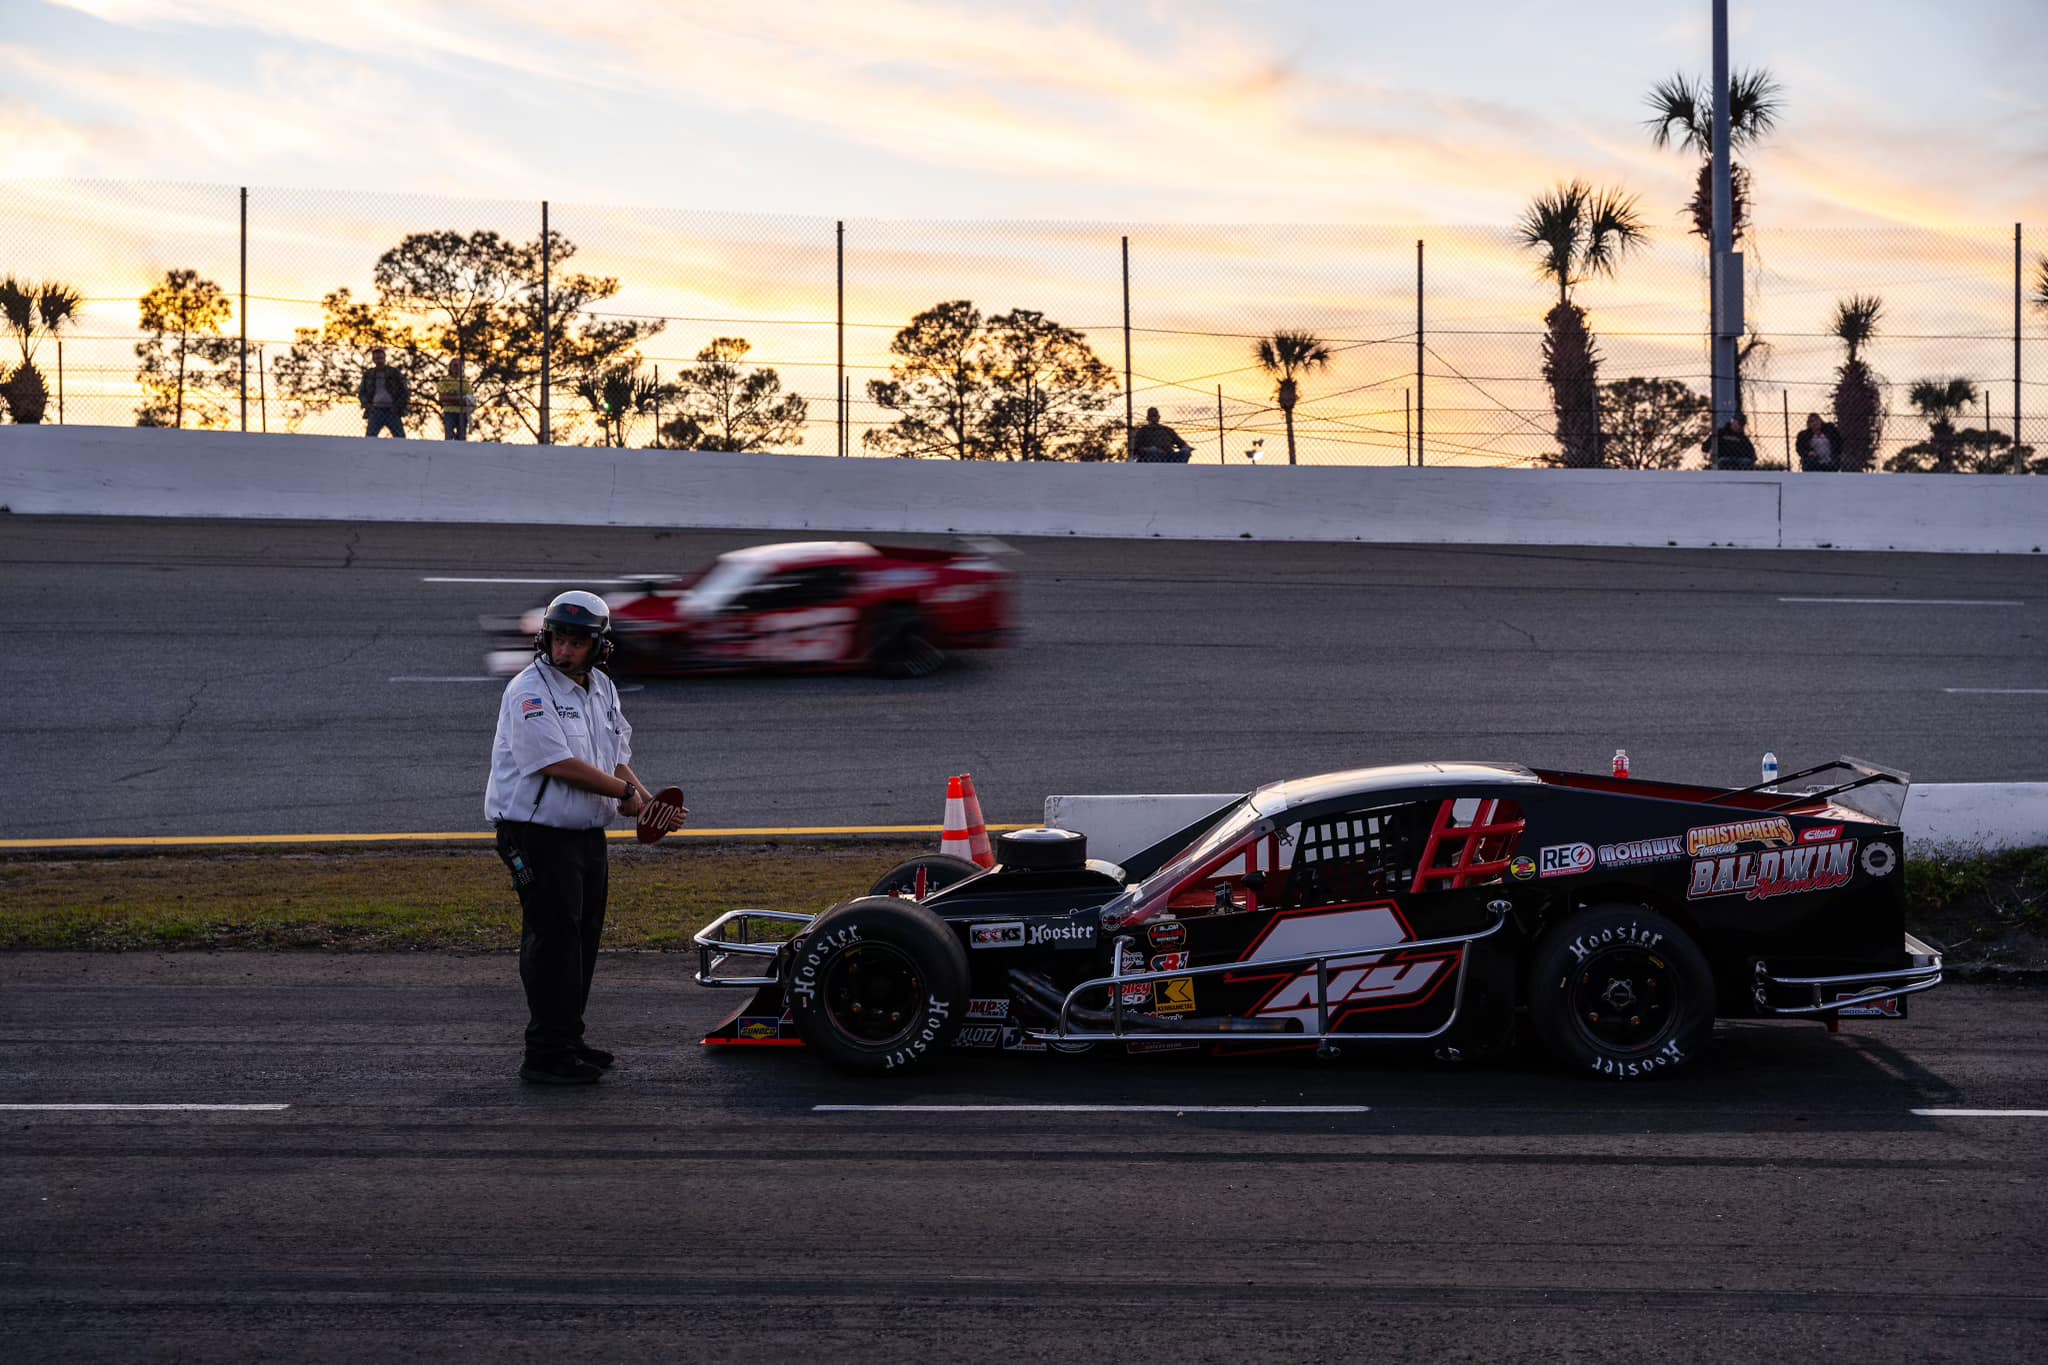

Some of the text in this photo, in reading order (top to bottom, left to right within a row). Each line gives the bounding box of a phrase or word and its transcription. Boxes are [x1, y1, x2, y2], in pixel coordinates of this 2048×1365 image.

[1600, 838, 1681, 862] MOHAWK
[1688, 819, 1793, 854] CHRISTOPHER'S
[1690, 841, 1853, 896] BALDWIN
[1027, 922, 1095, 945] Hoosier
[1569, 922, 1663, 963] Hoosier
[794, 925, 858, 1000] Hoosier
[740, 1026, 777, 1037] SUNOCO
[885, 994, 949, 1070] Hoosier
[959, 1027, 997, 1042] KLOTZ
[1592, 1039, 1685, 1081] Hoosier
